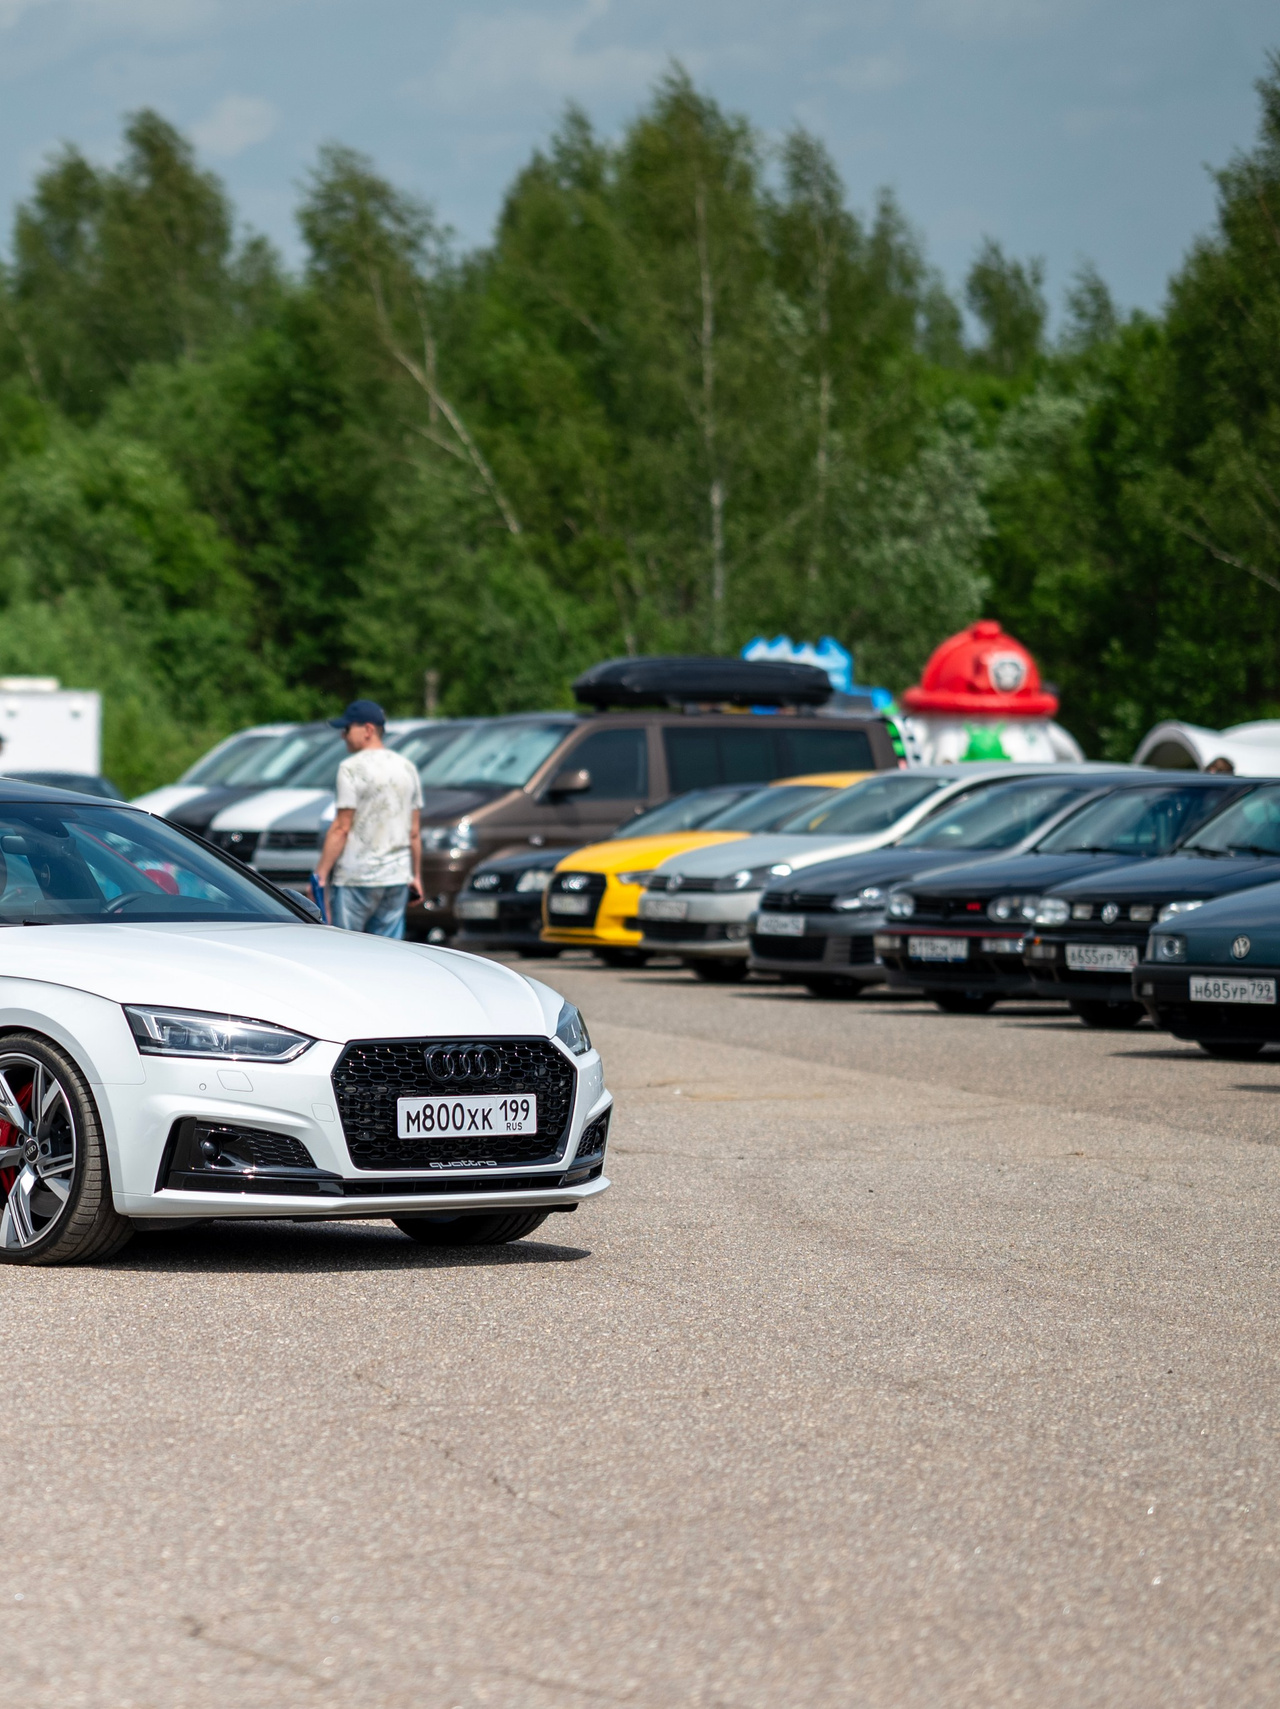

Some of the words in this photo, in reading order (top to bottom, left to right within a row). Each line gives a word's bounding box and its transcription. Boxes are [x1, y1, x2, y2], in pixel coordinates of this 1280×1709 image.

[1250, 983, 1271, 998] 799
[499, 1098, 530, 1122] 199
[506, 1122, 523, 1131] RUS
[429, 1159, 498, 1170] quattro
